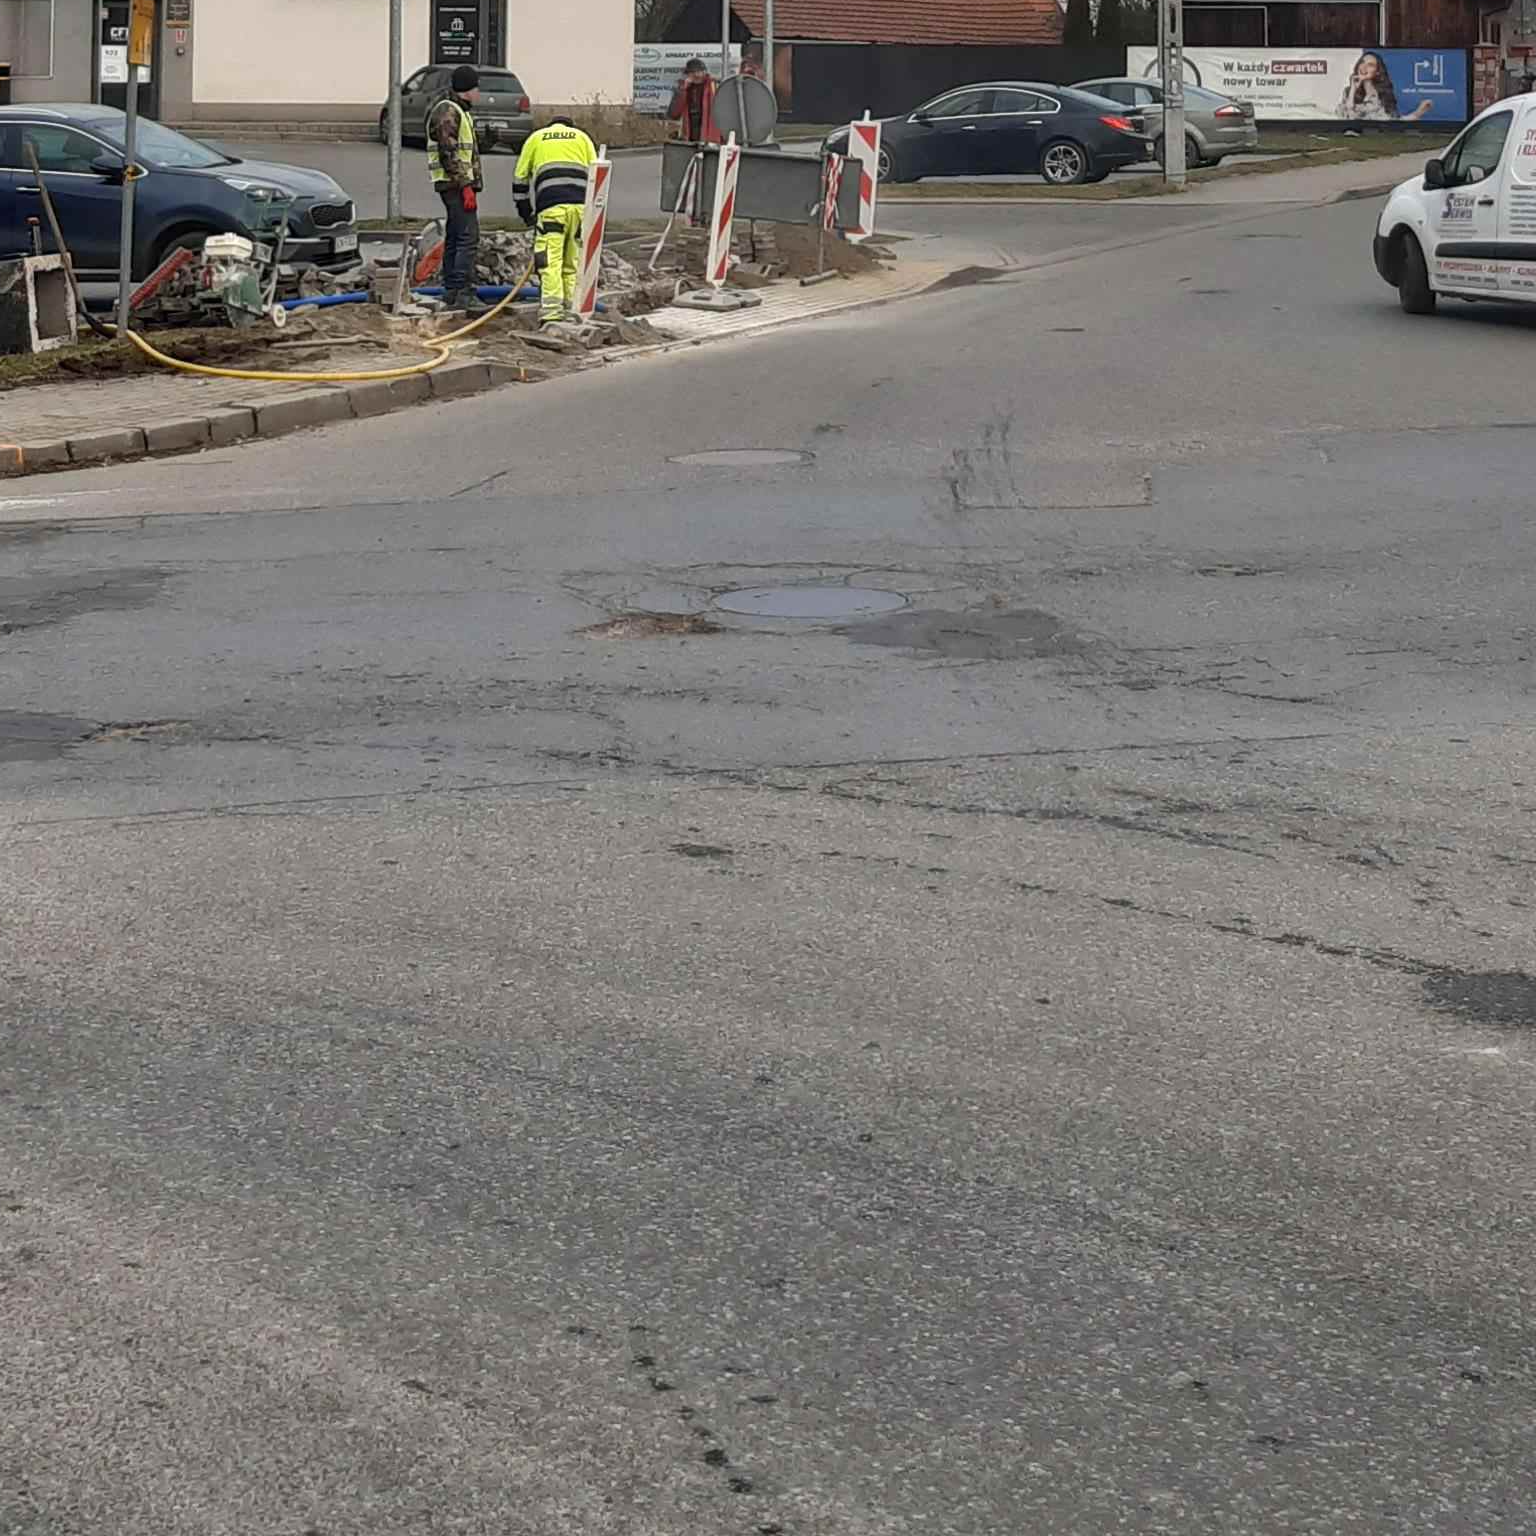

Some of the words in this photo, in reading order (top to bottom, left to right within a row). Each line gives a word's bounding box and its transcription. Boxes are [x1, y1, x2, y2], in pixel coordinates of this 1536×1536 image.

[1224, 62, 1234, 72] W
[1272, 62, 1325, 73] czwartek
[1224, 77, 1252, 88] nowy
[1256, 77, 1288, 87] towar
